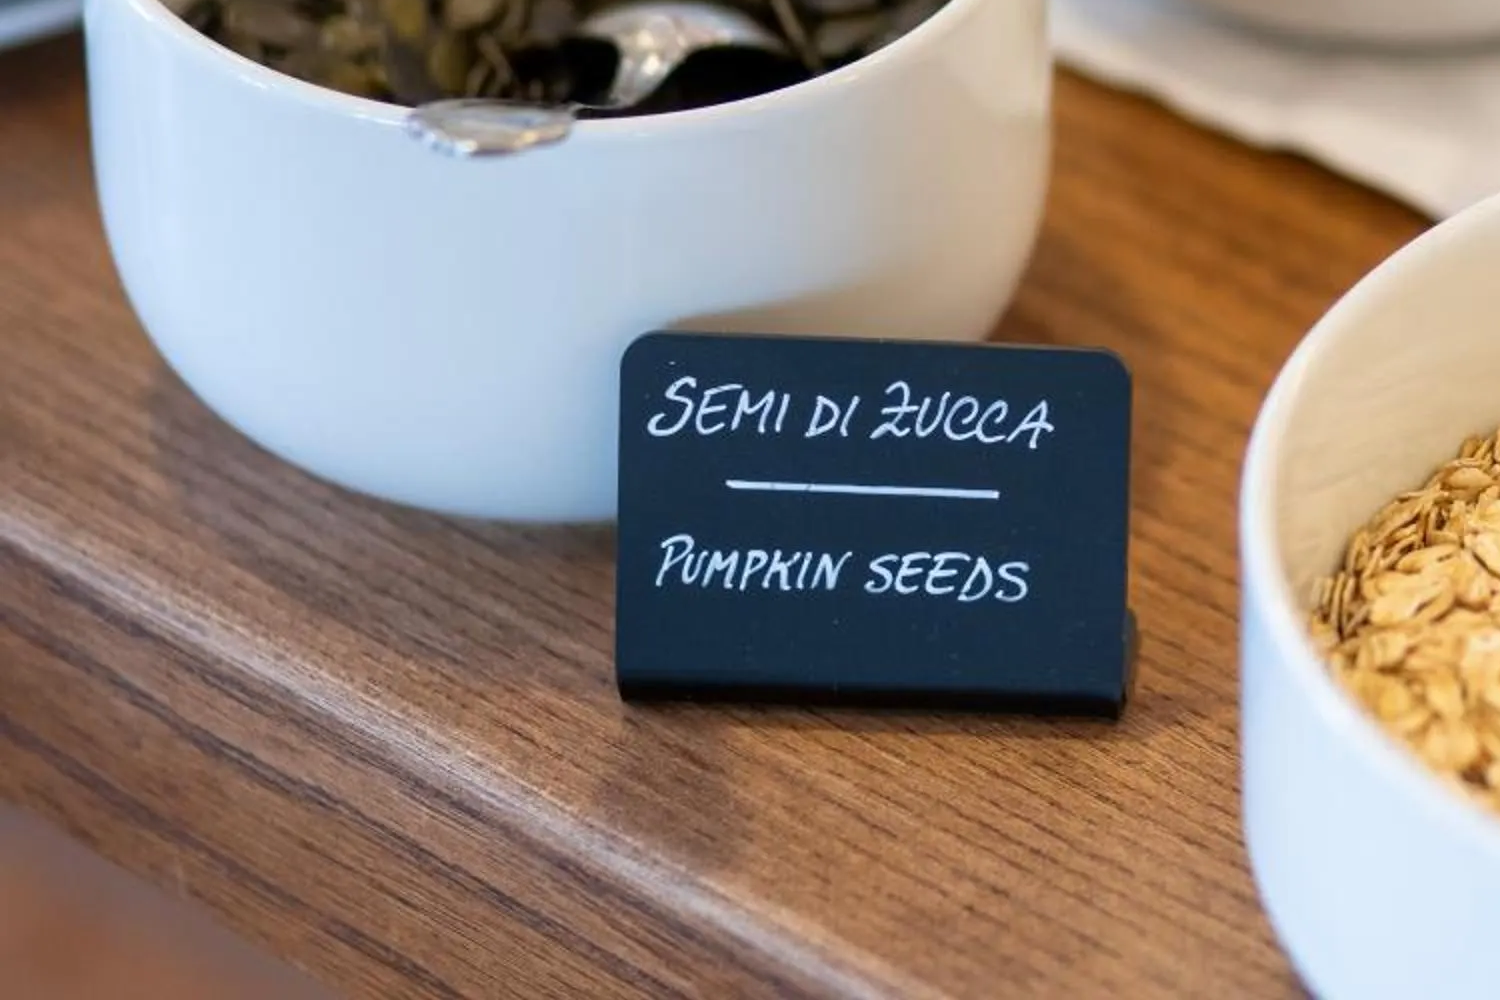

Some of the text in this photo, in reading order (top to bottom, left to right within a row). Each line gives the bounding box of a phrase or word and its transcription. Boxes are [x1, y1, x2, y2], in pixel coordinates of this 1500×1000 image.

[647, 375, 1055, 449] SEMI DI ZUCCA
[655, 534, 1029, 602] PUMPKIN SEEDS
